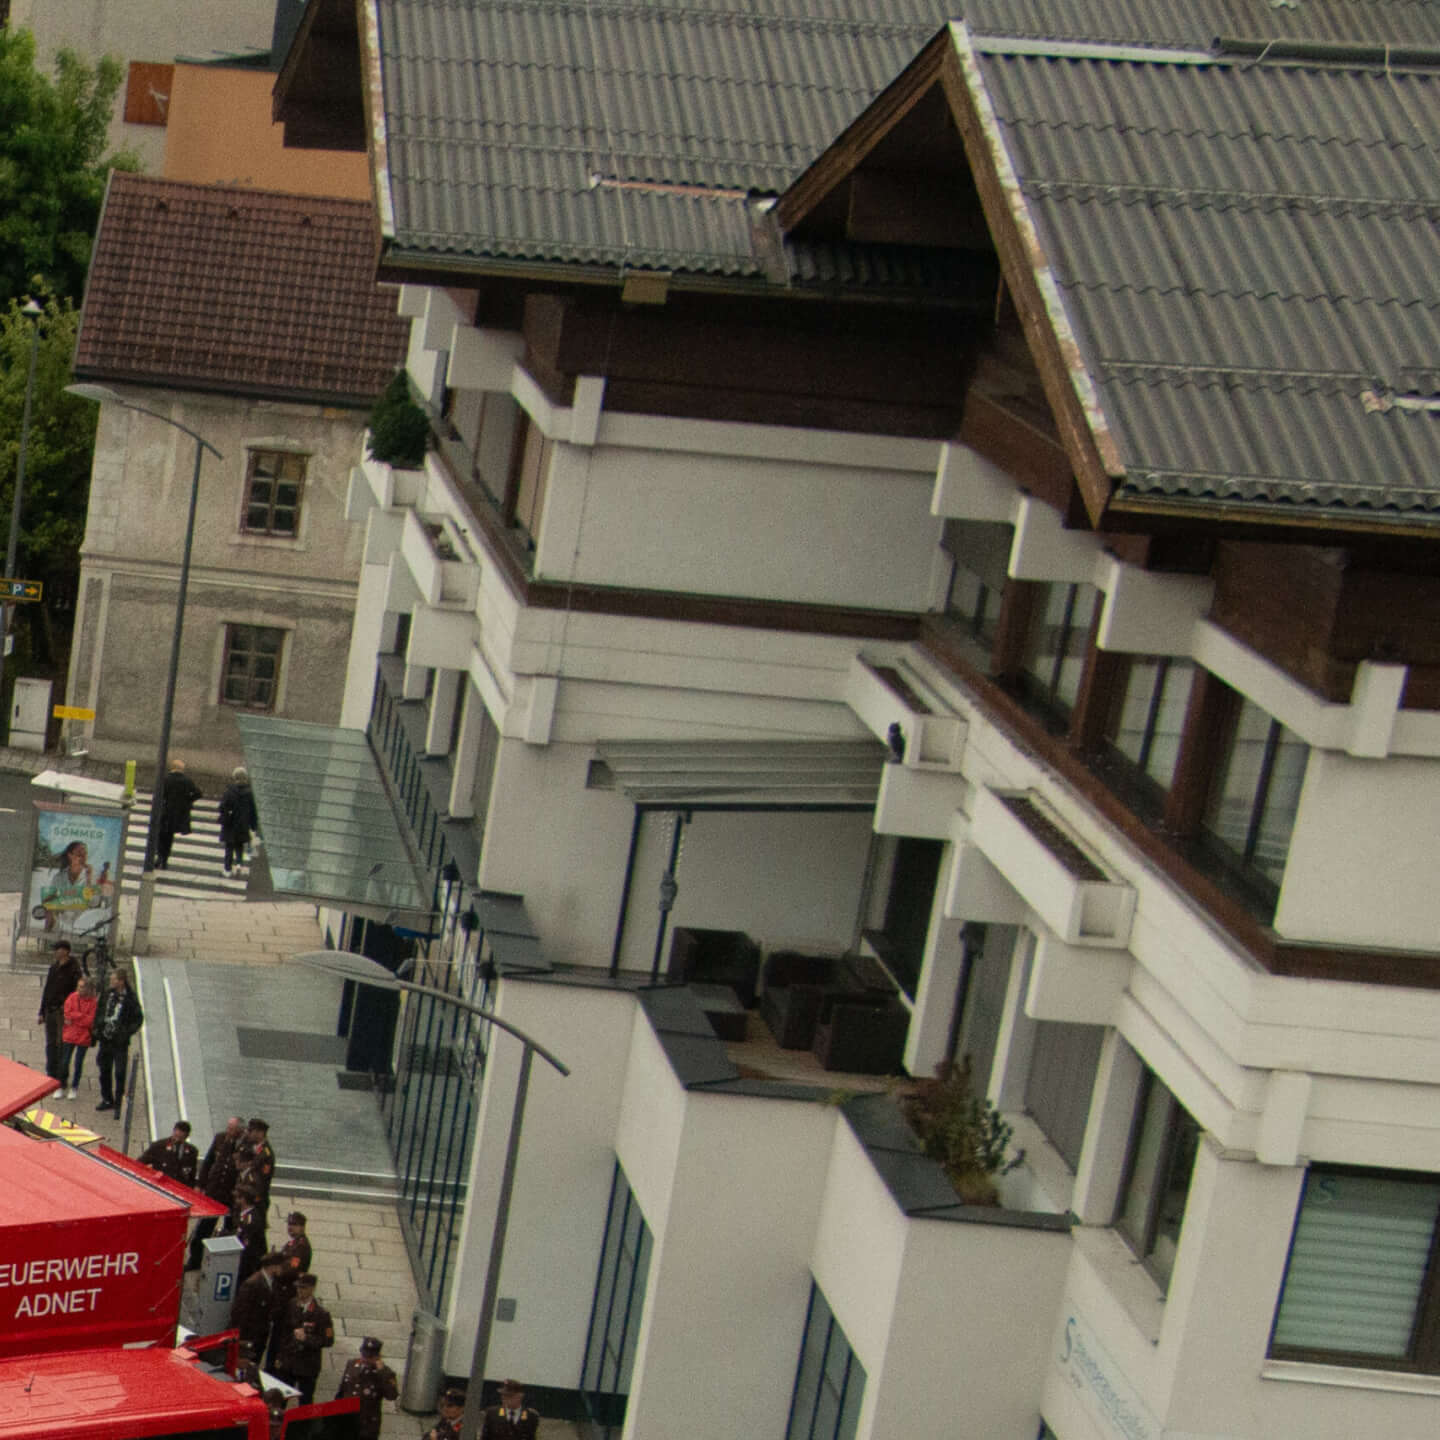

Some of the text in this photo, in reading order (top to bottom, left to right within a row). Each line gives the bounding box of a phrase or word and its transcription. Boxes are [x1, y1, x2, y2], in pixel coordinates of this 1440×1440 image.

[54, 827, 105, 840] SOMMER
[217, 1274, 231, 1292] P
[14, 1288, 103, 1320] ADNET
